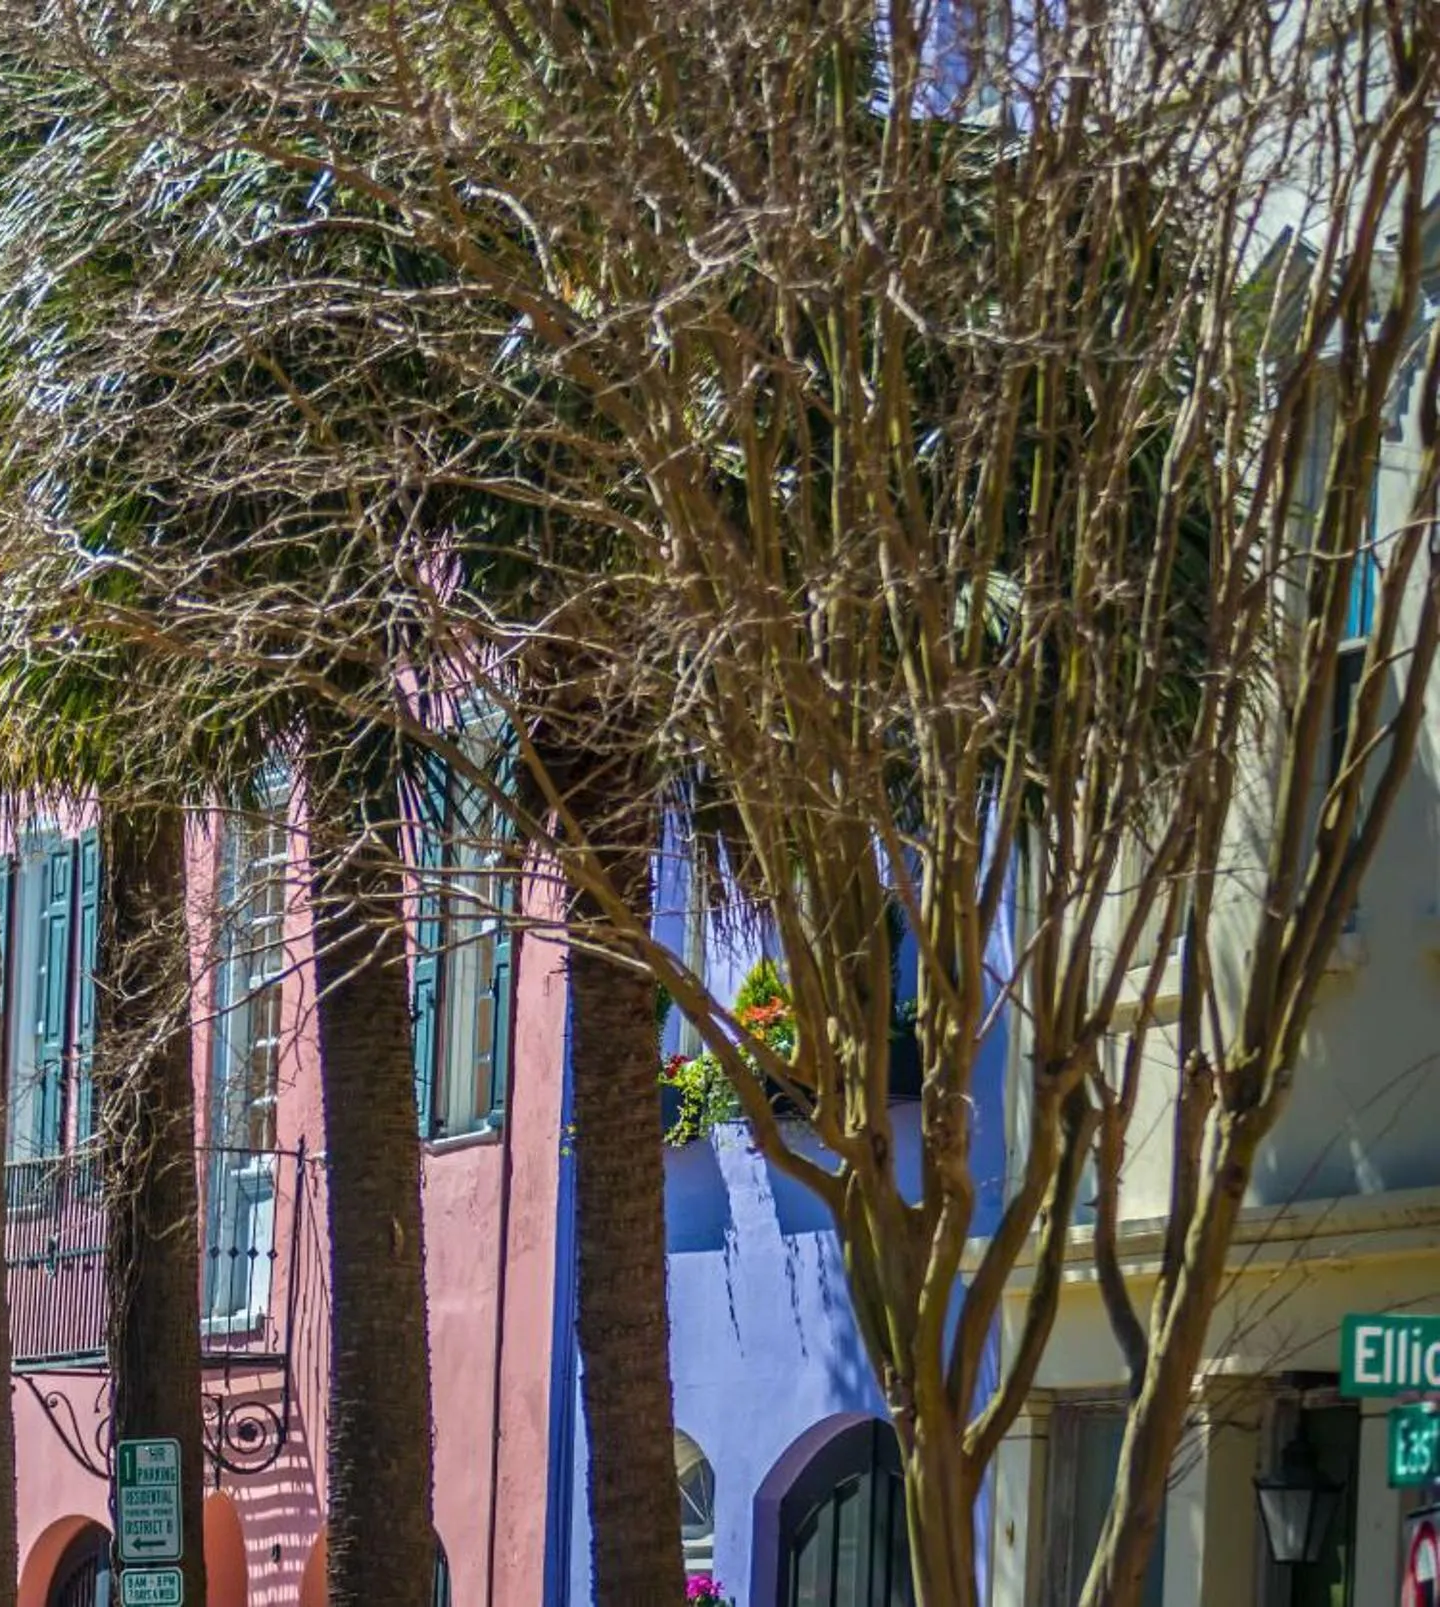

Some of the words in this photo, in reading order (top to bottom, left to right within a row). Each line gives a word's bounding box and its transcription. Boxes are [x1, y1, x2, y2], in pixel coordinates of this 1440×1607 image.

[124, 1451, 131, 1481] 1
[137, 1465, 177, 1483] PARKING
[125, 1489, 173, 1506] RESIDENTIAL
[125, 1519, 162, 1536] DISTRICT
